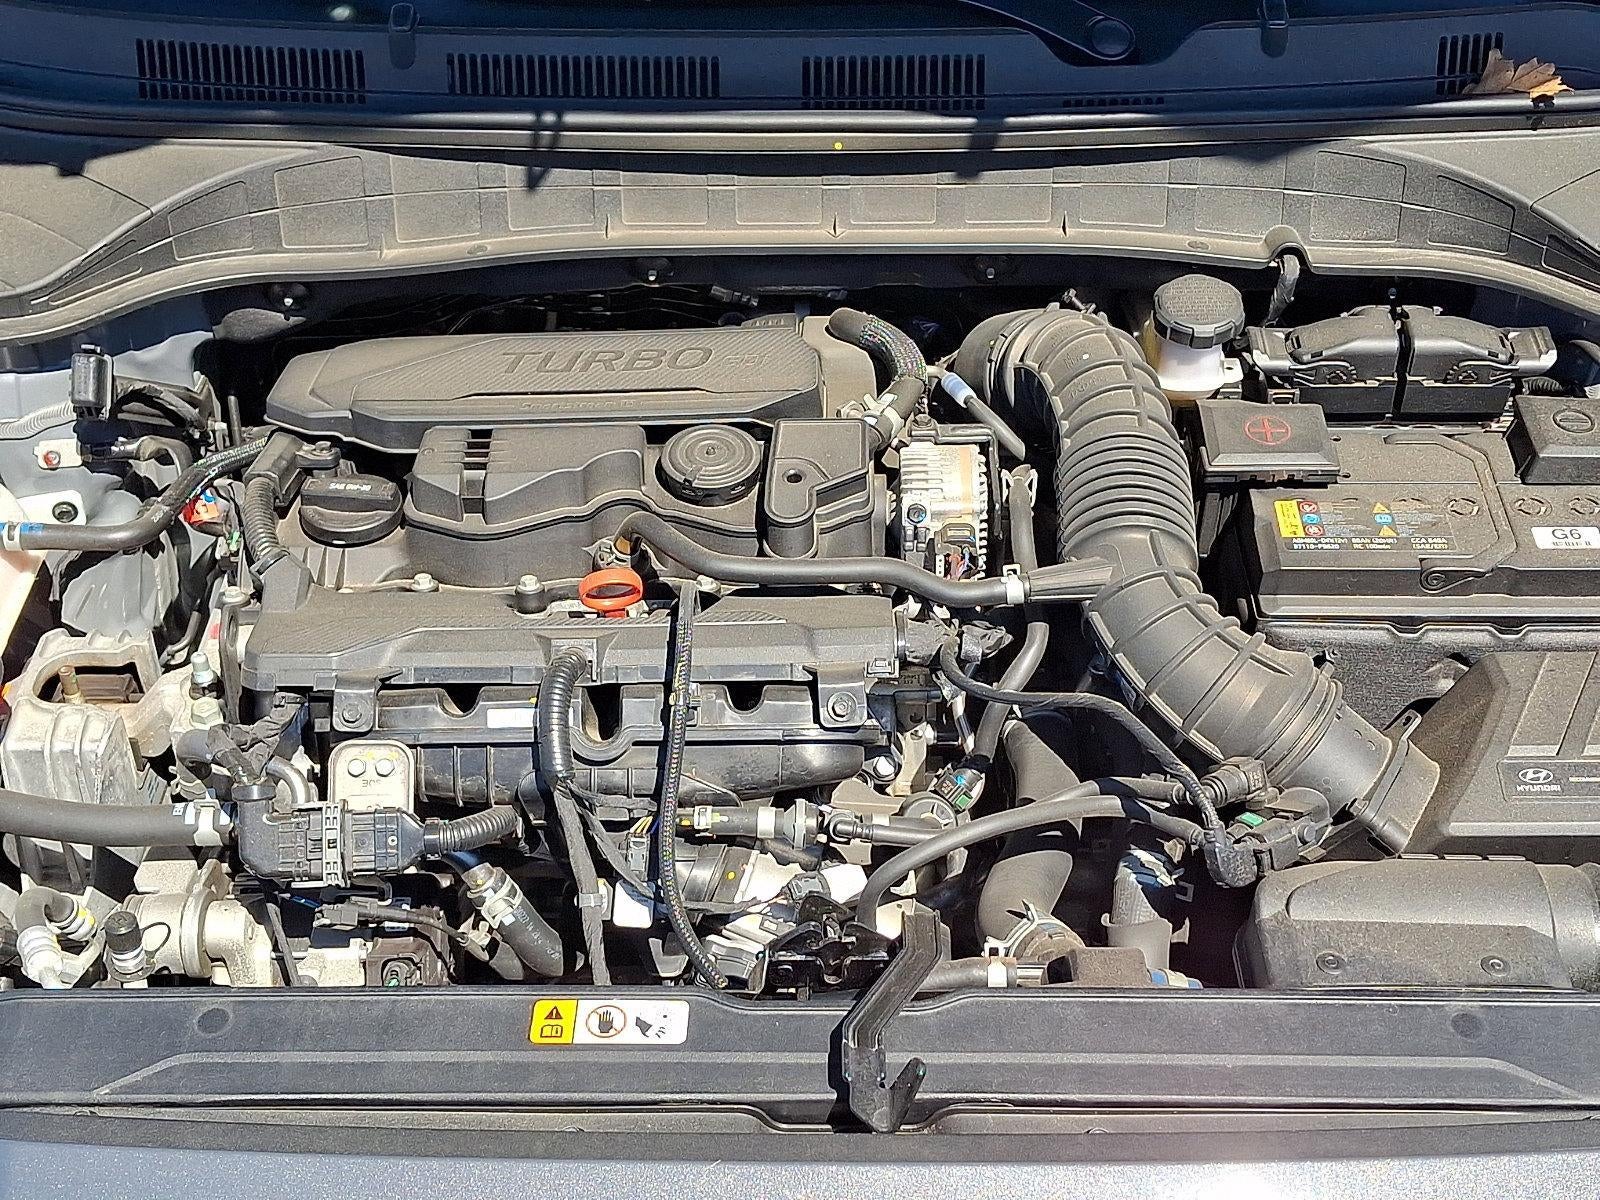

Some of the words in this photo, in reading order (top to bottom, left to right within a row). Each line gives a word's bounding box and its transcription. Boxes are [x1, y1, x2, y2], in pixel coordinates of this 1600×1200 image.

[502, 347, 713, 374] TURBO
[1552, 528, 1581, 540] G6
[1516, 784, 1561, 792] HYUNDAI
